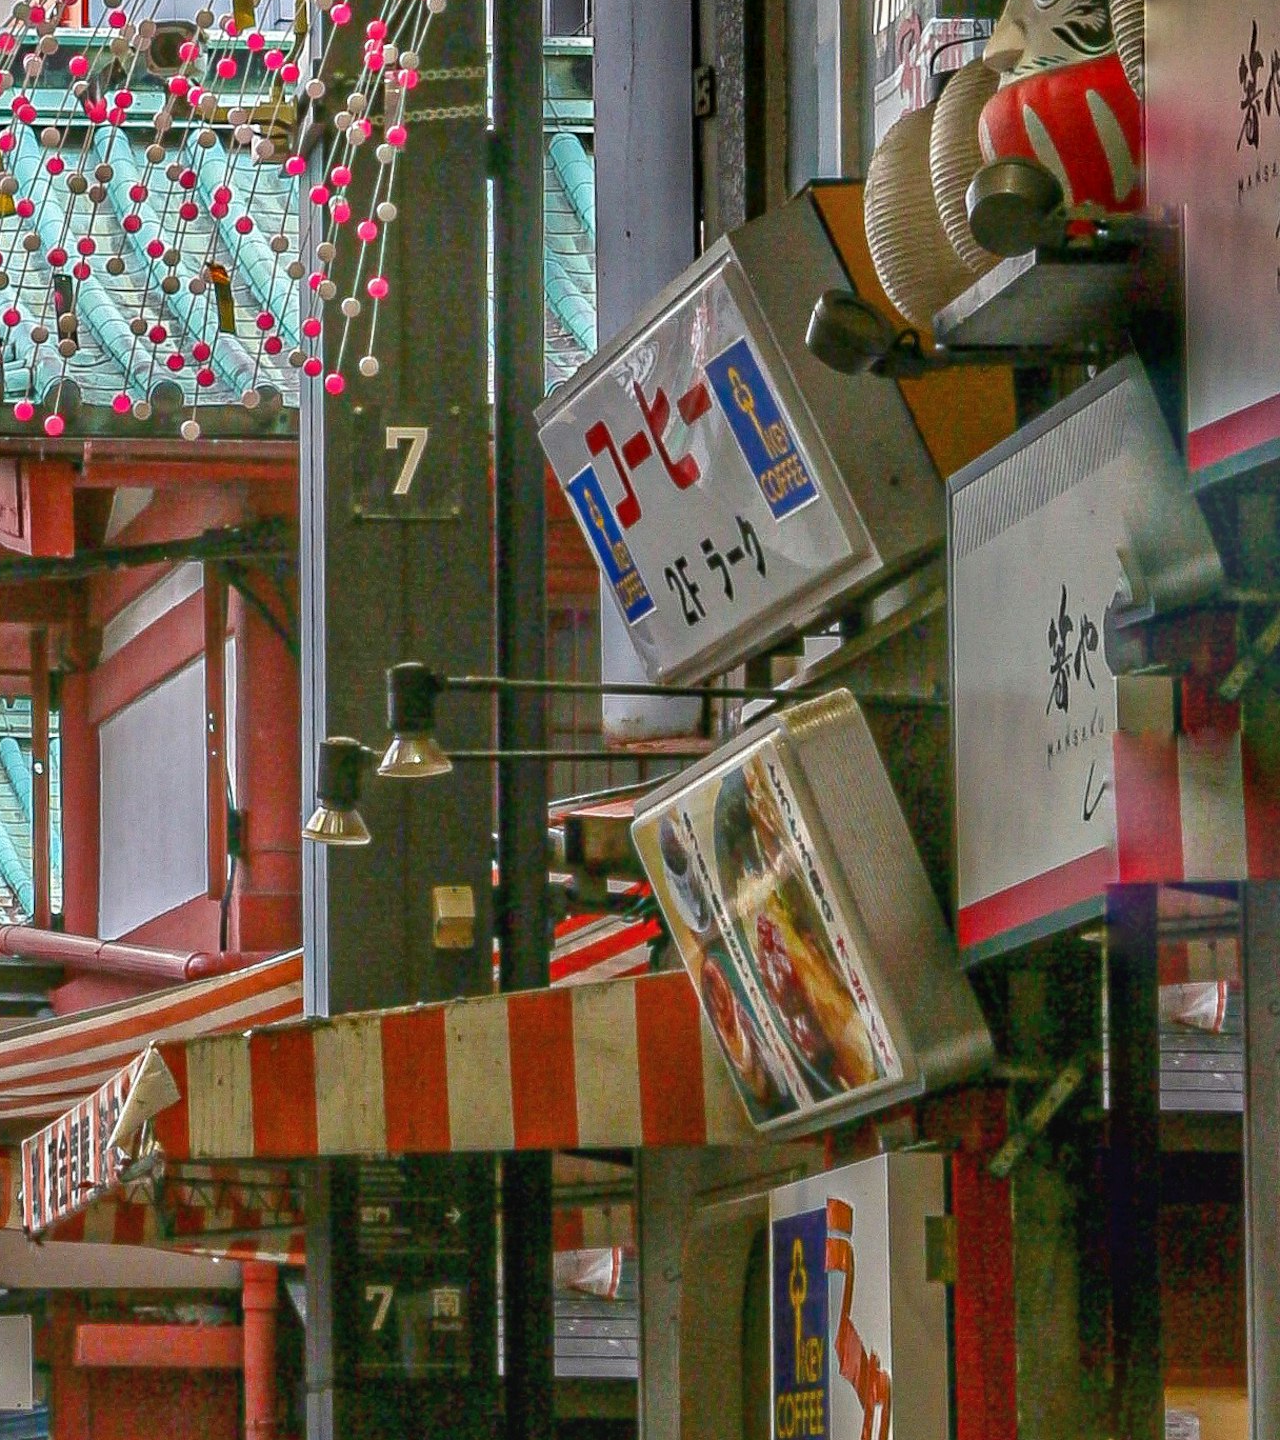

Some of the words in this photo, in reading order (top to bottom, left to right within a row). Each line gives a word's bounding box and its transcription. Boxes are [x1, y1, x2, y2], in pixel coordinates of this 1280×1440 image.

[384, 426, 429, 496] 7
[584, 381, 713, 530] コーヒー
[758, 455, 808, 504] COFFEE
[664, 556, 706, 625] 2F
[700, 514, 768, 602] ラーク
[365, 1285, 394, 1332] 7
